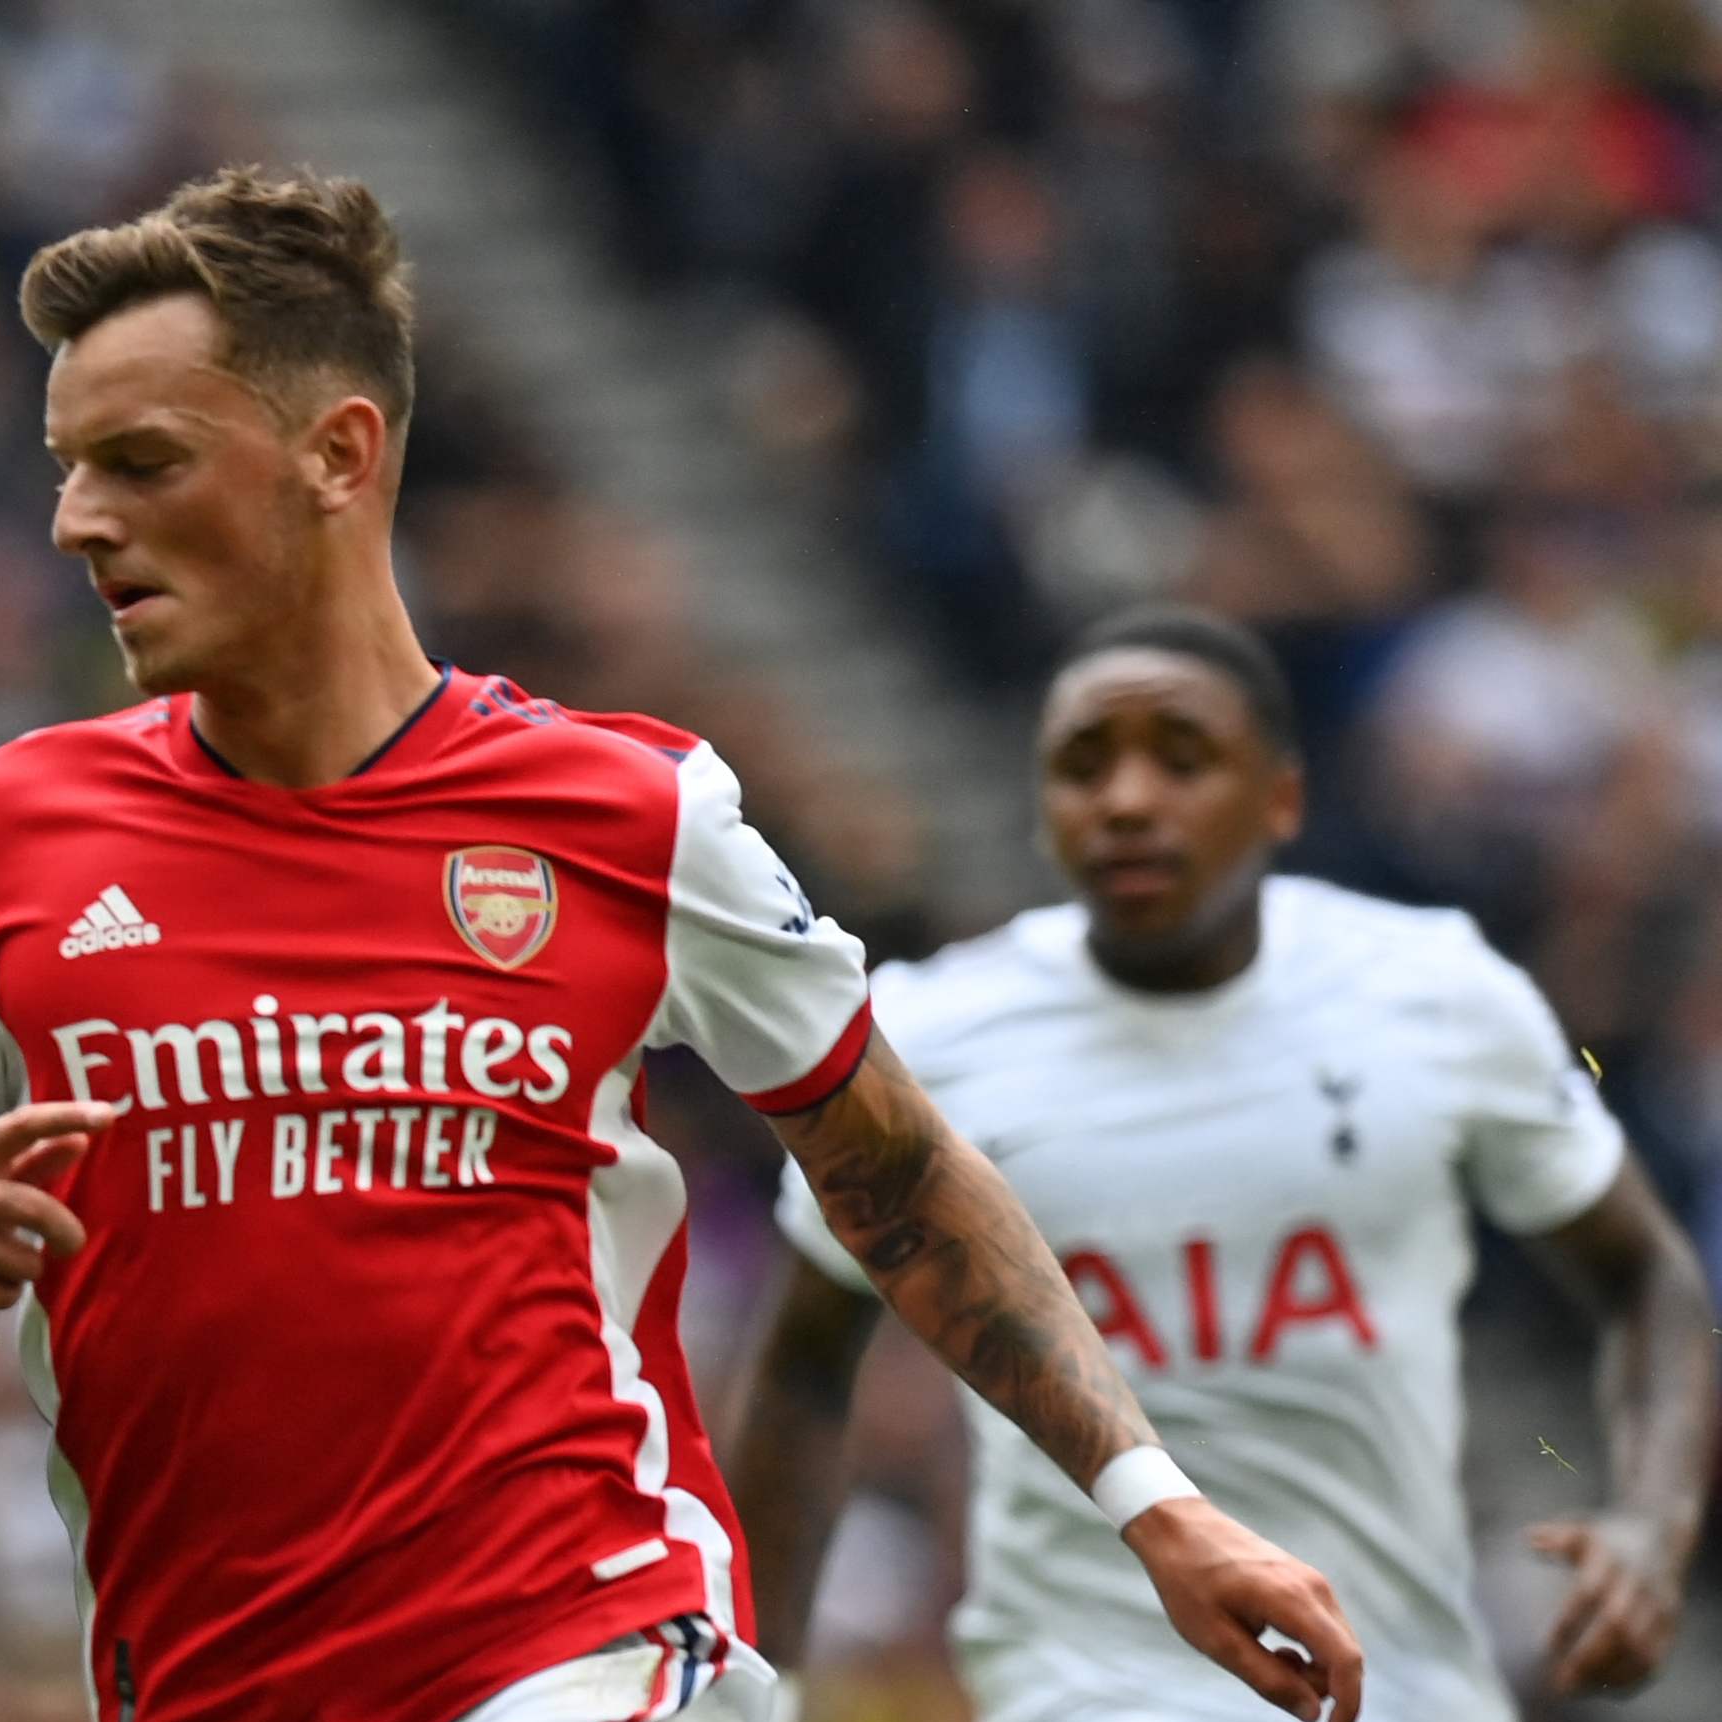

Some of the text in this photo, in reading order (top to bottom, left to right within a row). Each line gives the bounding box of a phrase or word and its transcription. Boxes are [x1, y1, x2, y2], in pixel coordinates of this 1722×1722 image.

[59, 922, 162, 960] adidas
[50, 995, 573, 1116] Emirates
[146, 1106, 498, 1213] FLY BETTER
[1056, 1221, 1380, 1370] AIA
